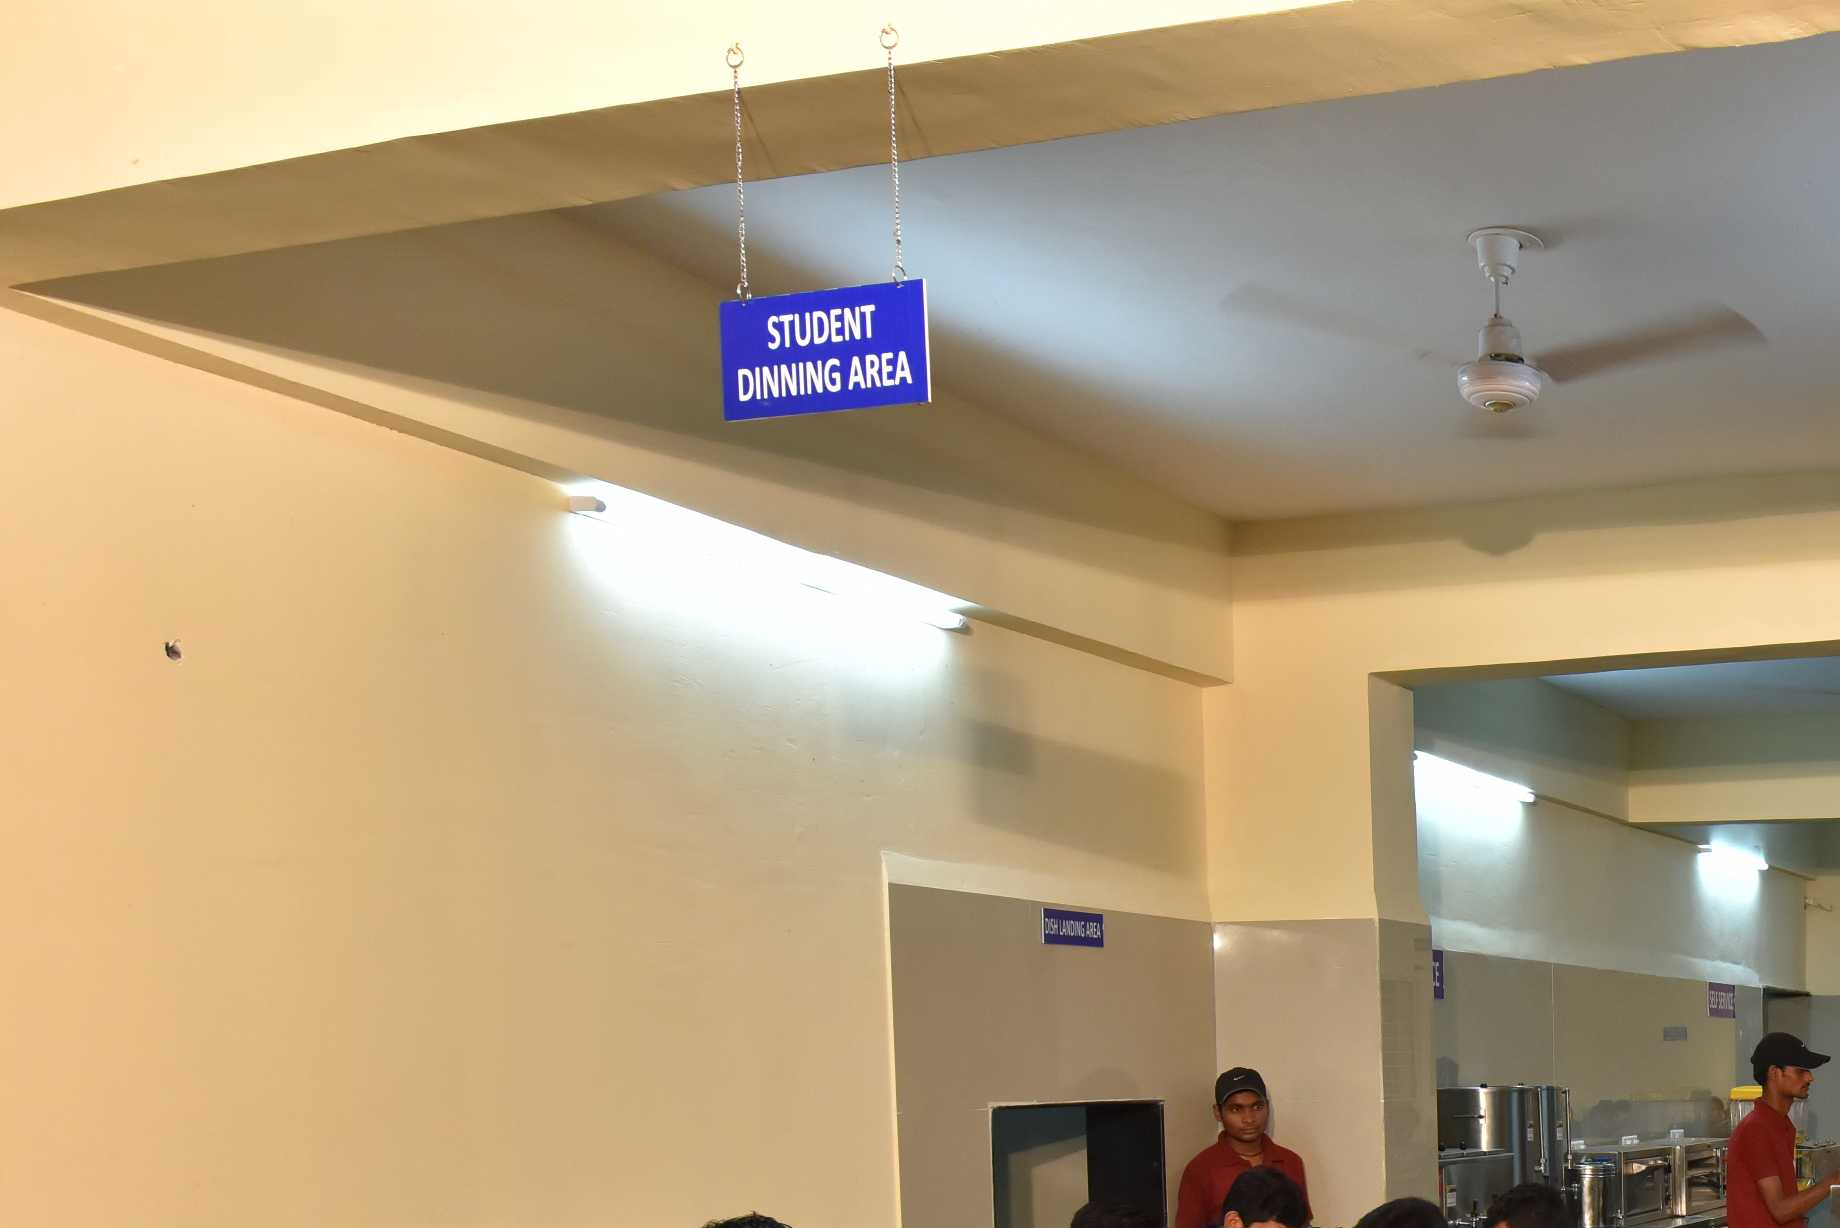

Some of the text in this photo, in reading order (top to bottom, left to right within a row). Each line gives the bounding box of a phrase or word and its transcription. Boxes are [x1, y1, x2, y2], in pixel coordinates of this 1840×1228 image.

[767, 304, 876, 350] STUDENT
[737, 350, 913, 402] DINNING AREA
[1045, 917, 1102, 939] DISH LANDING AREA
[1709, 990, 1718, 1008] SELF
